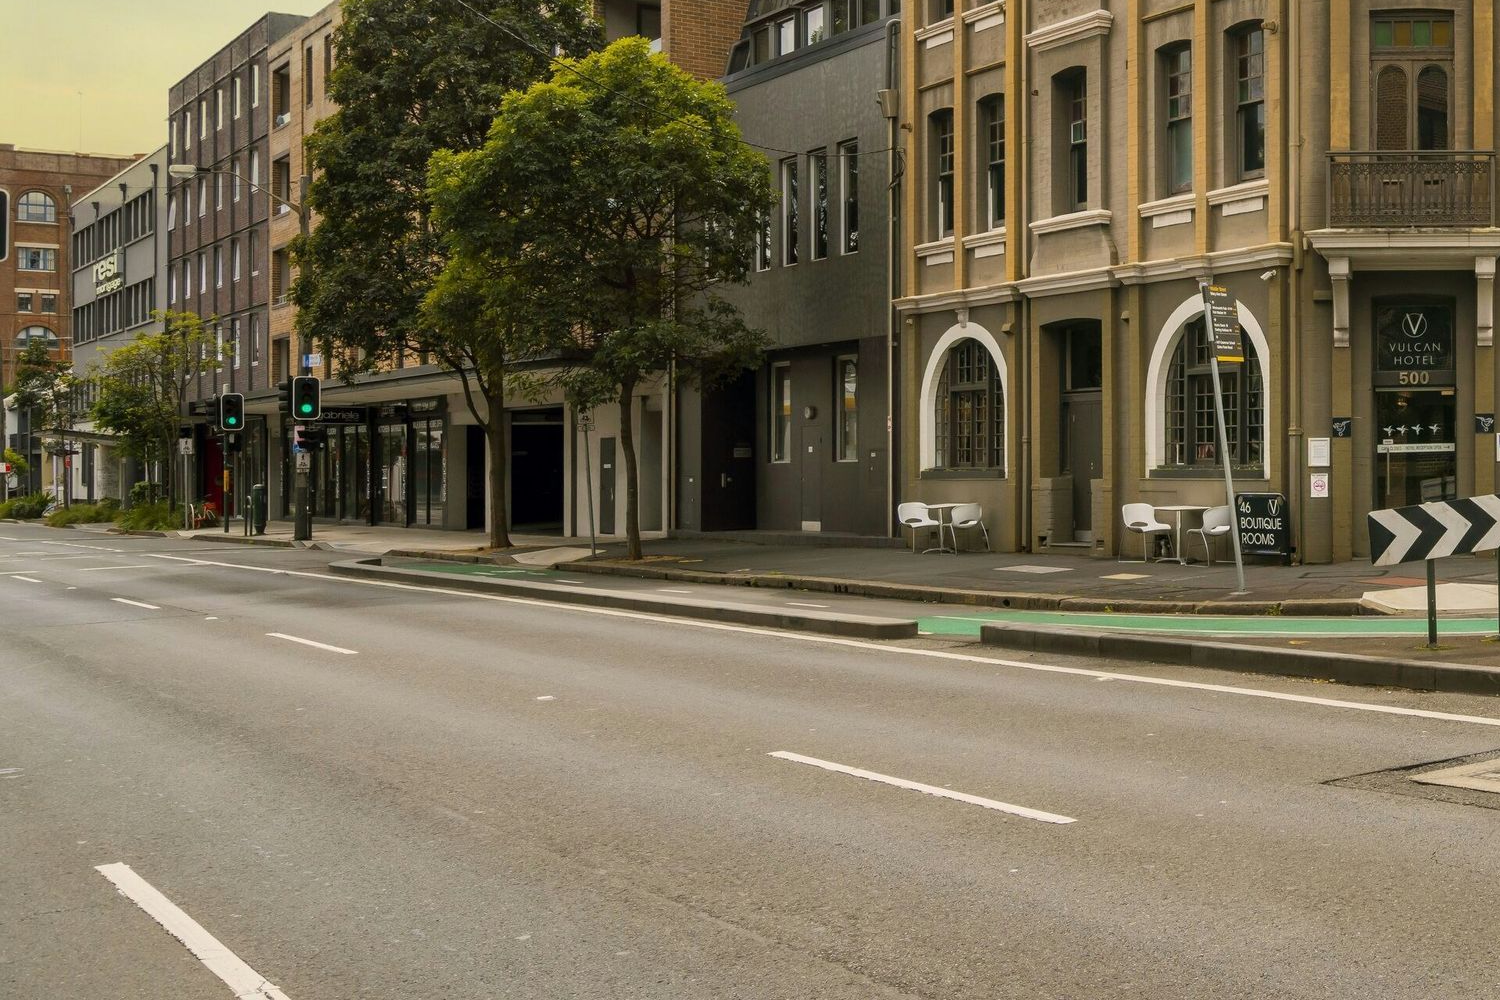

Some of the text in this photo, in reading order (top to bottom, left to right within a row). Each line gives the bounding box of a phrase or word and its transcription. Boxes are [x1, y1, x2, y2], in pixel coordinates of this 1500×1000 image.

[93, 249, 117, 282] resi
[1404, 312, 1425, 336] V
[1389, 342, 1441, 353] VULCAN
[1393, 355, 1436, 366] HOTEL
[1399, 370, 1430, 385] 500
[1240, 501, 1251, 513] 46
[1240, 517, 1282, 530] BOUTIQUE
[1241, 532, 1275, 546] ROOMS
